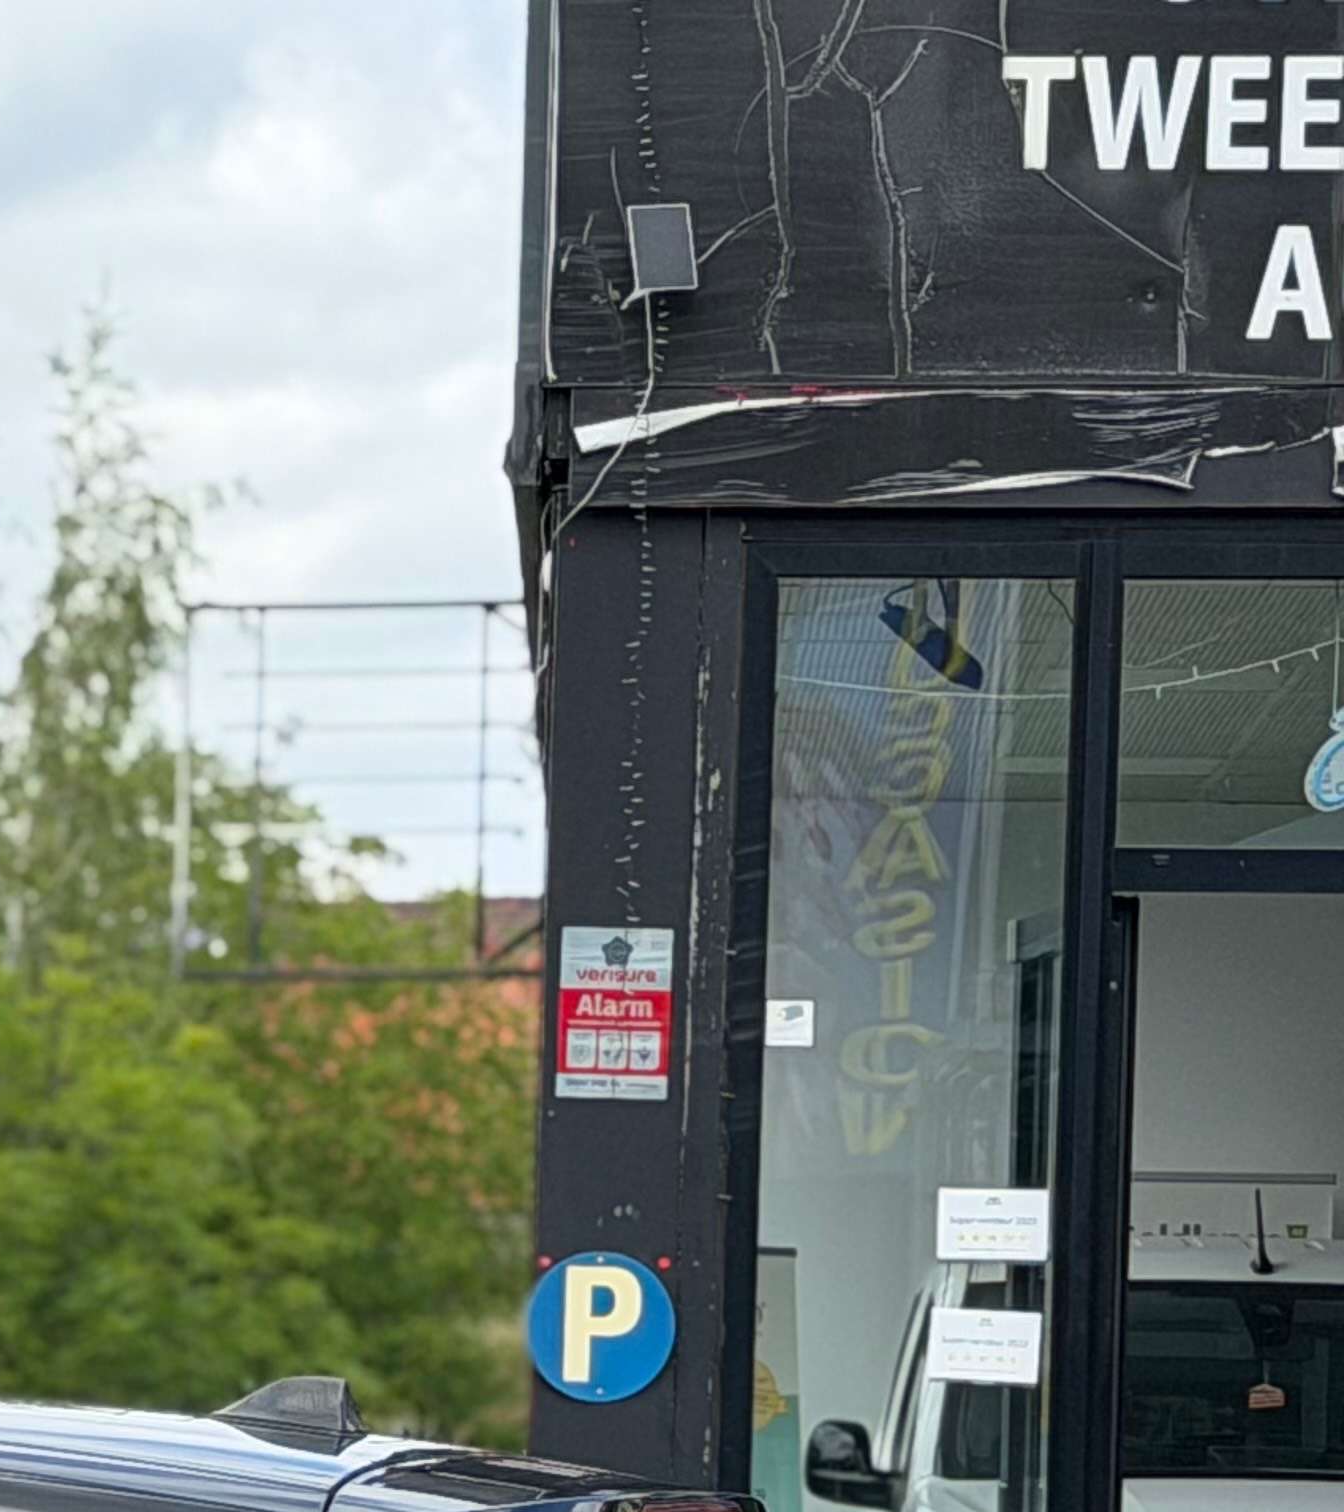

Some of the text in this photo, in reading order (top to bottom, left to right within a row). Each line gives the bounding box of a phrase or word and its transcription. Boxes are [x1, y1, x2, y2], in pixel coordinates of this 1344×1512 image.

[1002, 56, 1344, 170] TWEE
[1245, 225, 1333, 340] A
[575, 993, 654, 1018] Alarm
[562, 1264, 643, 1384] P
